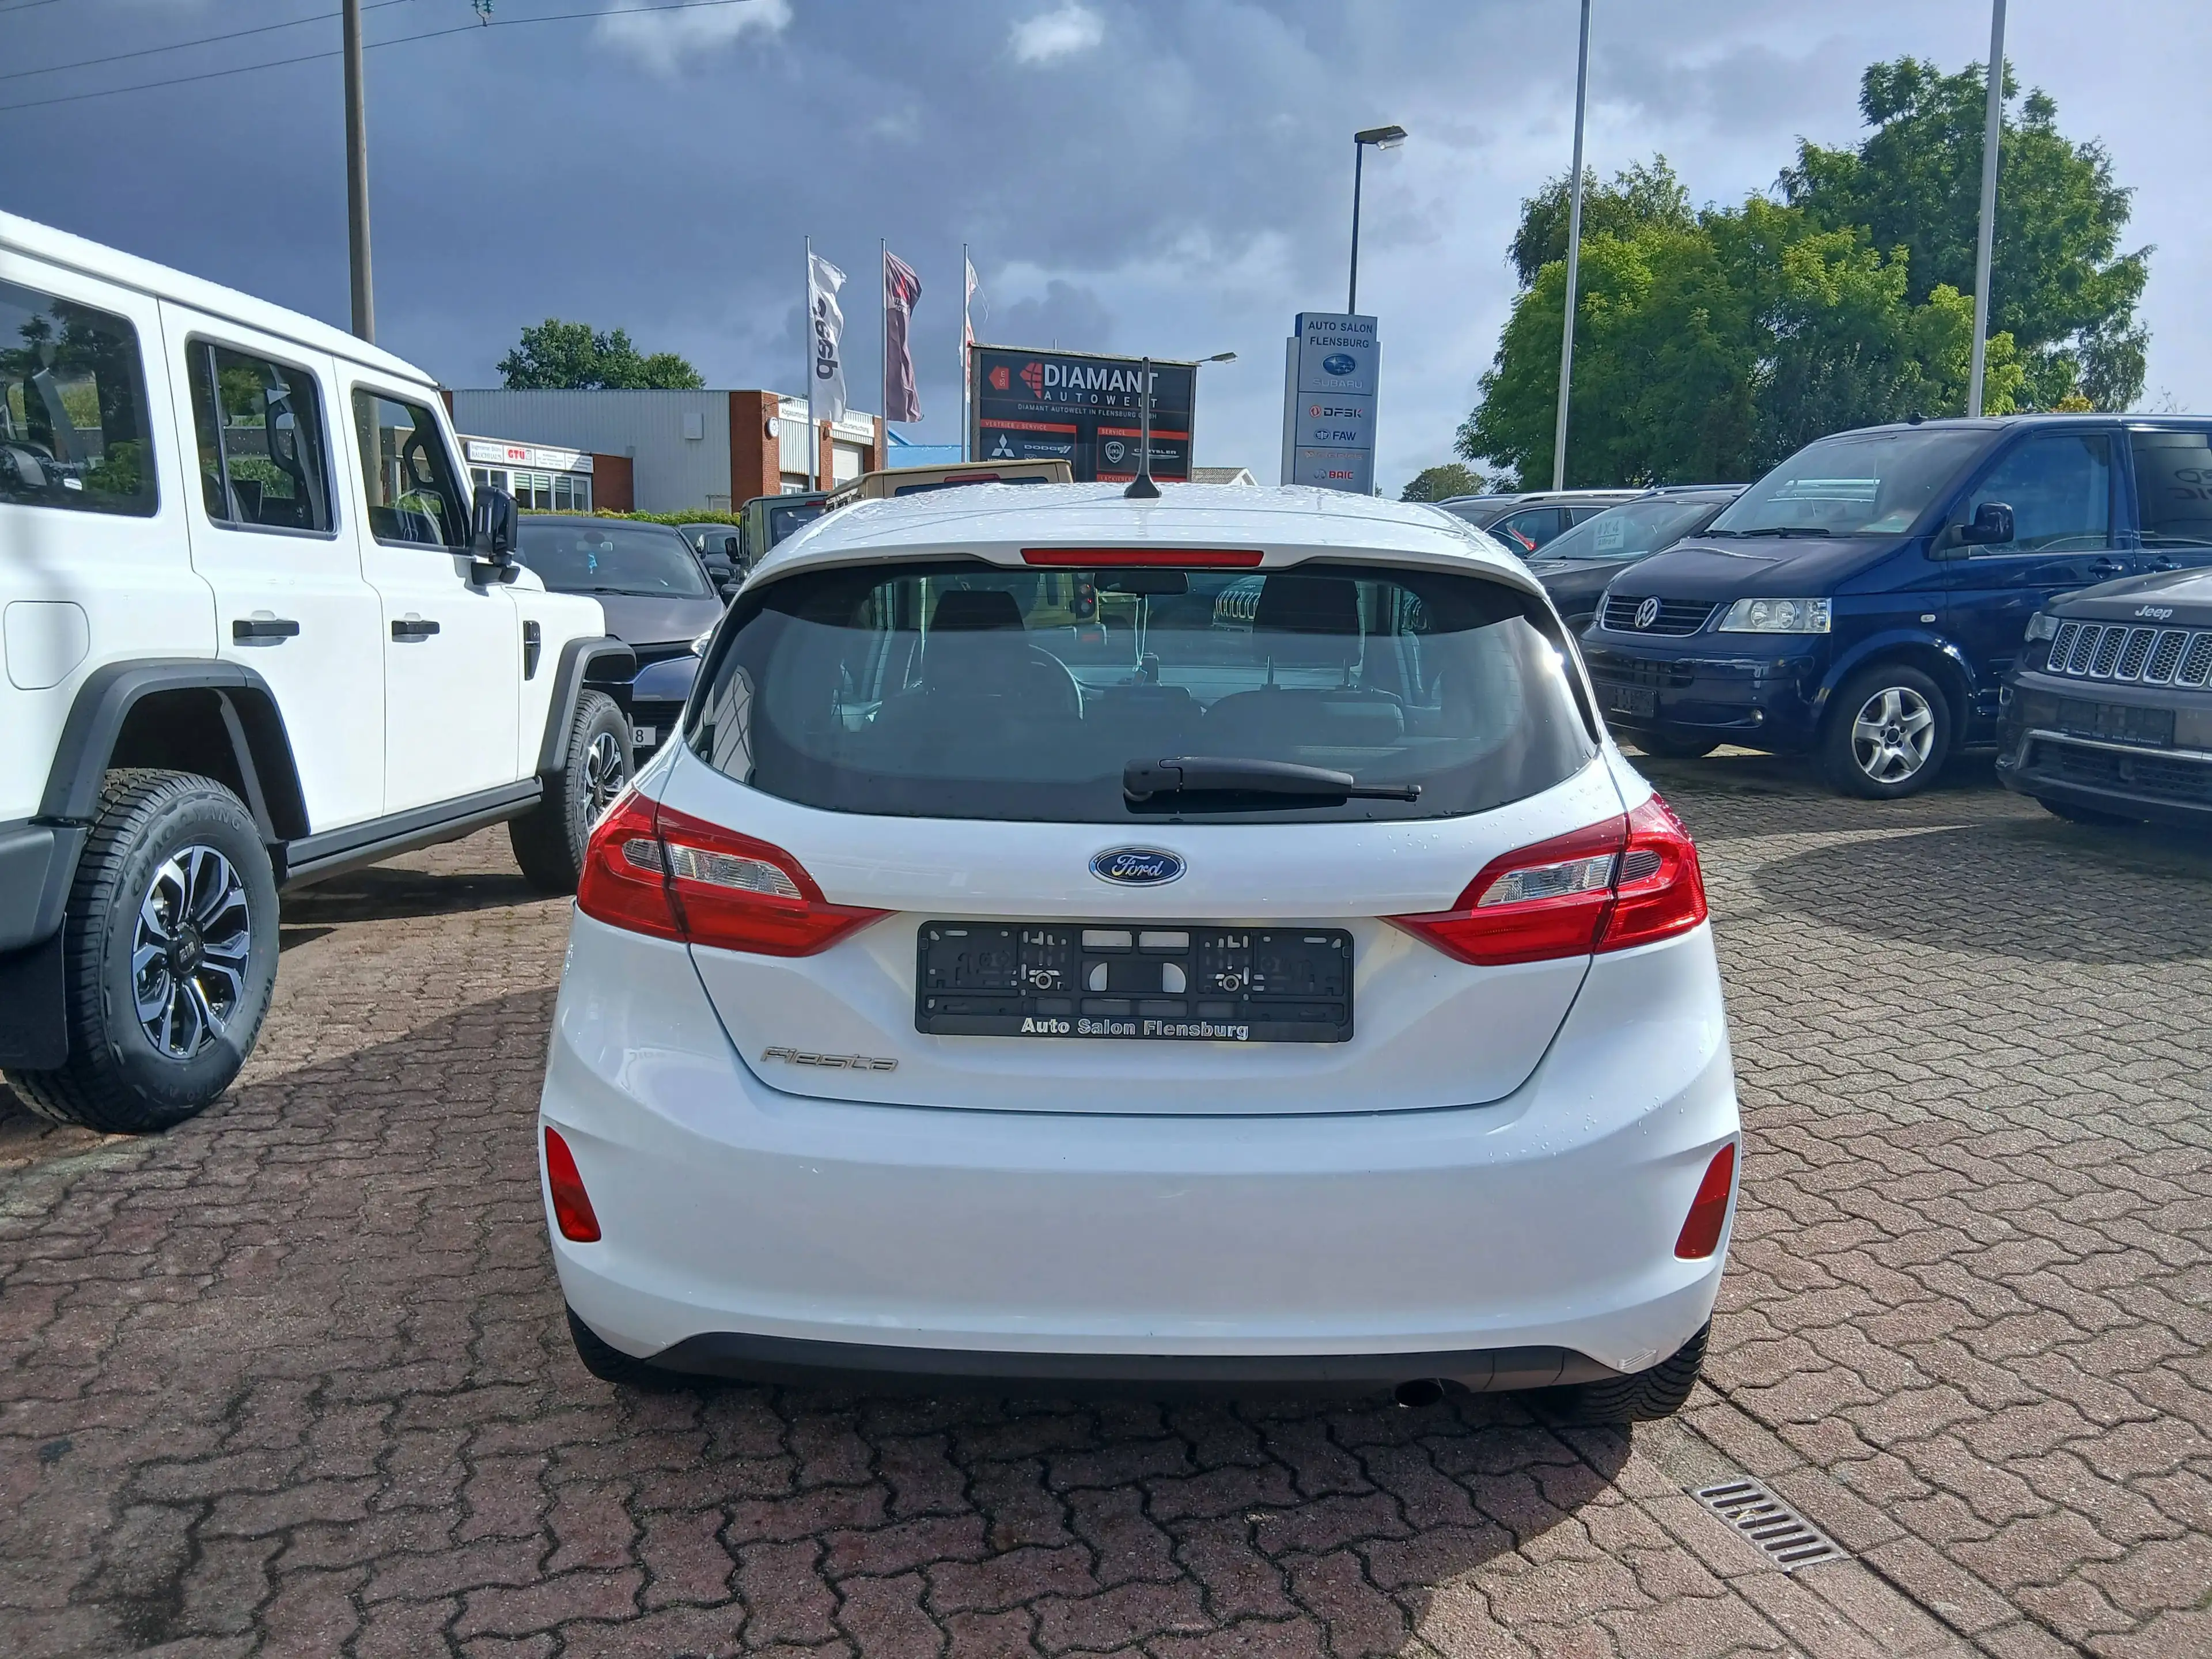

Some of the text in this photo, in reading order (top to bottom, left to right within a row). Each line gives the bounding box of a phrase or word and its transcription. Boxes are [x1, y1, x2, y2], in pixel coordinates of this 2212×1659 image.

[1308, 321, 1372, 333] AUTO SALON
[1310, 337, 1369, 348] FLENSBURG
[1044, 364, 1158, 394] DIAMANT
[1313, 378, 1362, 388] SUBARU
[1018, 404, 1048, 412] DIAMANT
[1051, 406, 1087, 415] AUTOWELT
[1099, 410, 1136, 418] FLENSBURG
[1324, 408, 1362, 418] DFSK
[1332, 431, 1357, 441] FAW
[508, 448, 525, 460] GTÜ
[1329, 470, 1354, 479] BAIC
[2135, 605, 2173, 620] Jeep
[635, 729, 644, 743] 8
[1111, 854, 1164, 877] Ford
[1021, 1017, 1249, 1040] Auto Salon Flensburg
[760, 1046, 899, 1072] Fiesta
